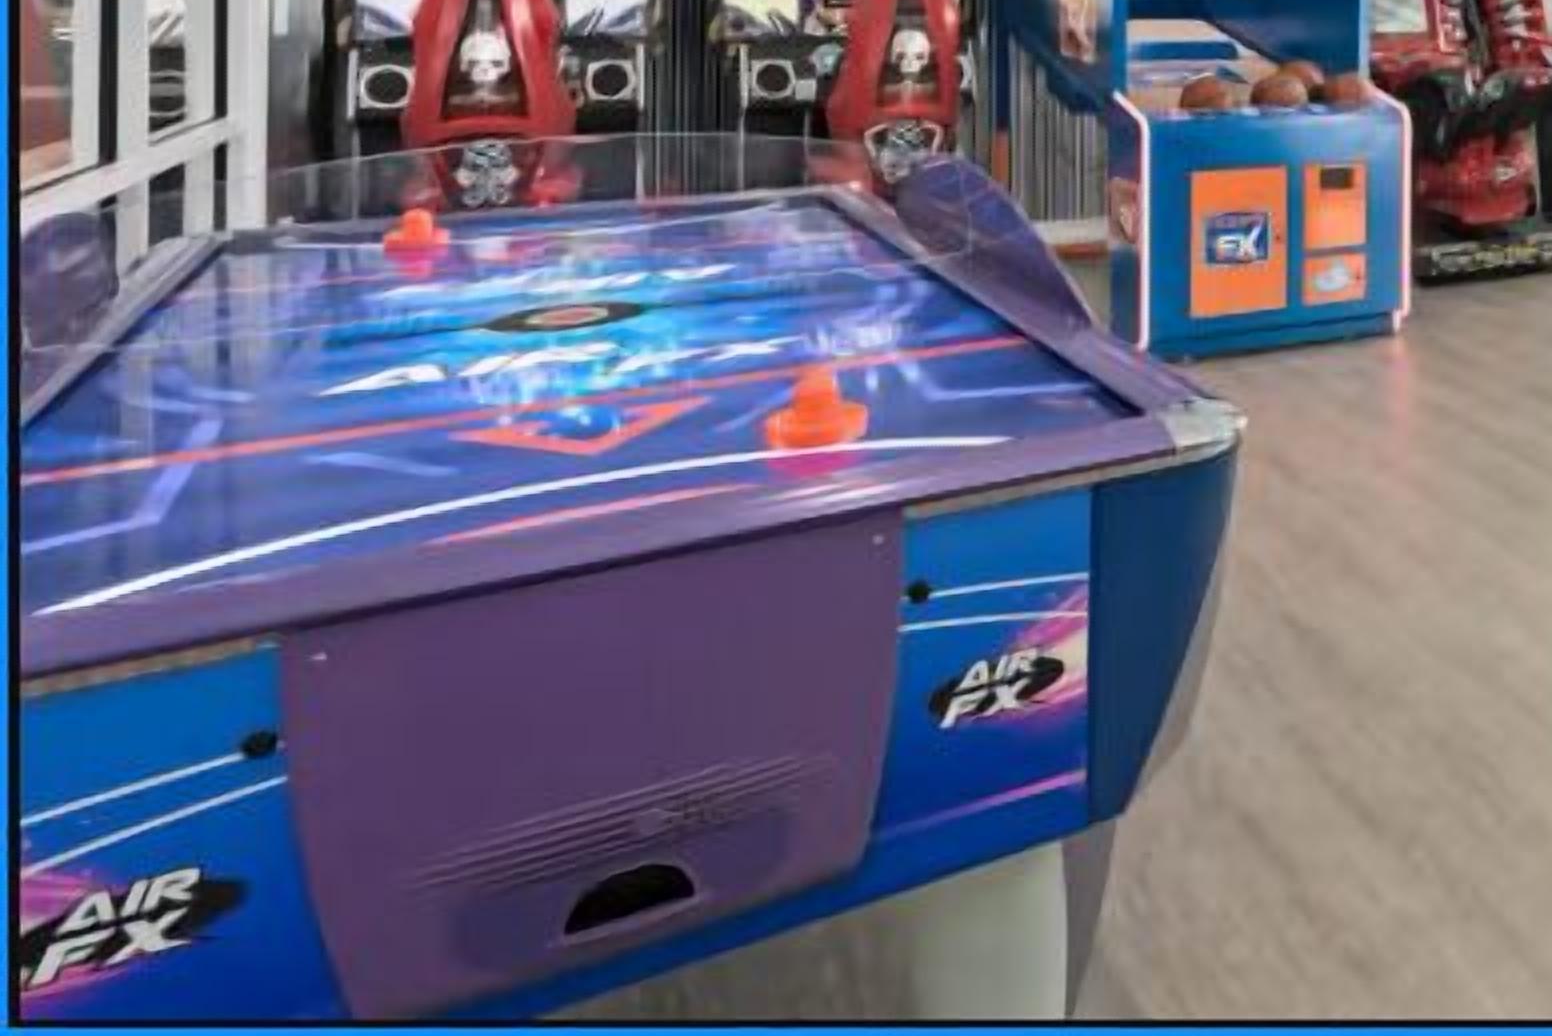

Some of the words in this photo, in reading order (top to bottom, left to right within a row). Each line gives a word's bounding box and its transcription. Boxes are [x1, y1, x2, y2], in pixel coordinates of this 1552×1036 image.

[955, 648, 1039, 693] AIR
[939, 676, 1033, 729] FX
[54, 867, 201, 937] AIR
[29, 906, 192, 987] FX
